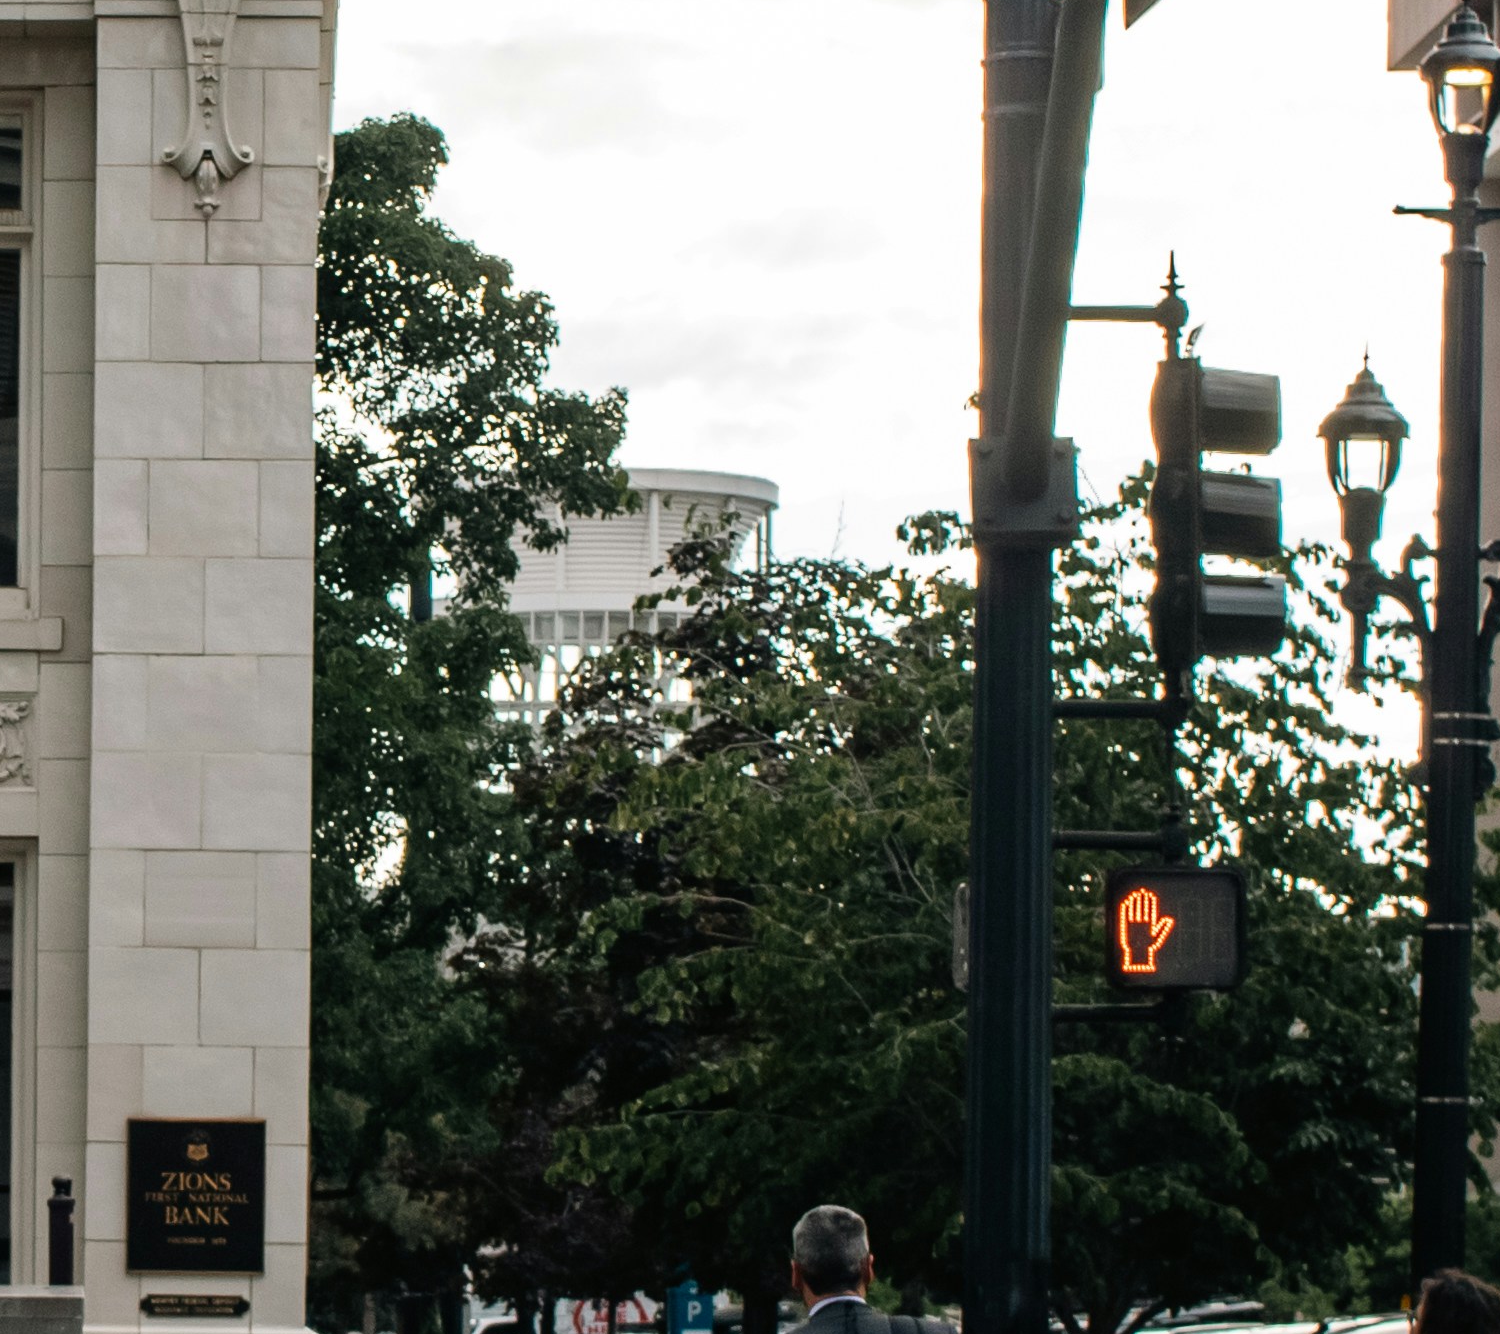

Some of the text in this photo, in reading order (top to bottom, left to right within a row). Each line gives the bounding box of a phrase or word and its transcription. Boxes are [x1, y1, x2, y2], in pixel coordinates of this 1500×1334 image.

[160, 1171, 233, 1192] ZIONS
[146, 1191, 249, 1204] FIRST NATIONAL
[164, 1205, 231, 1226] BANK
[687, 1300, 702, 1323] P
